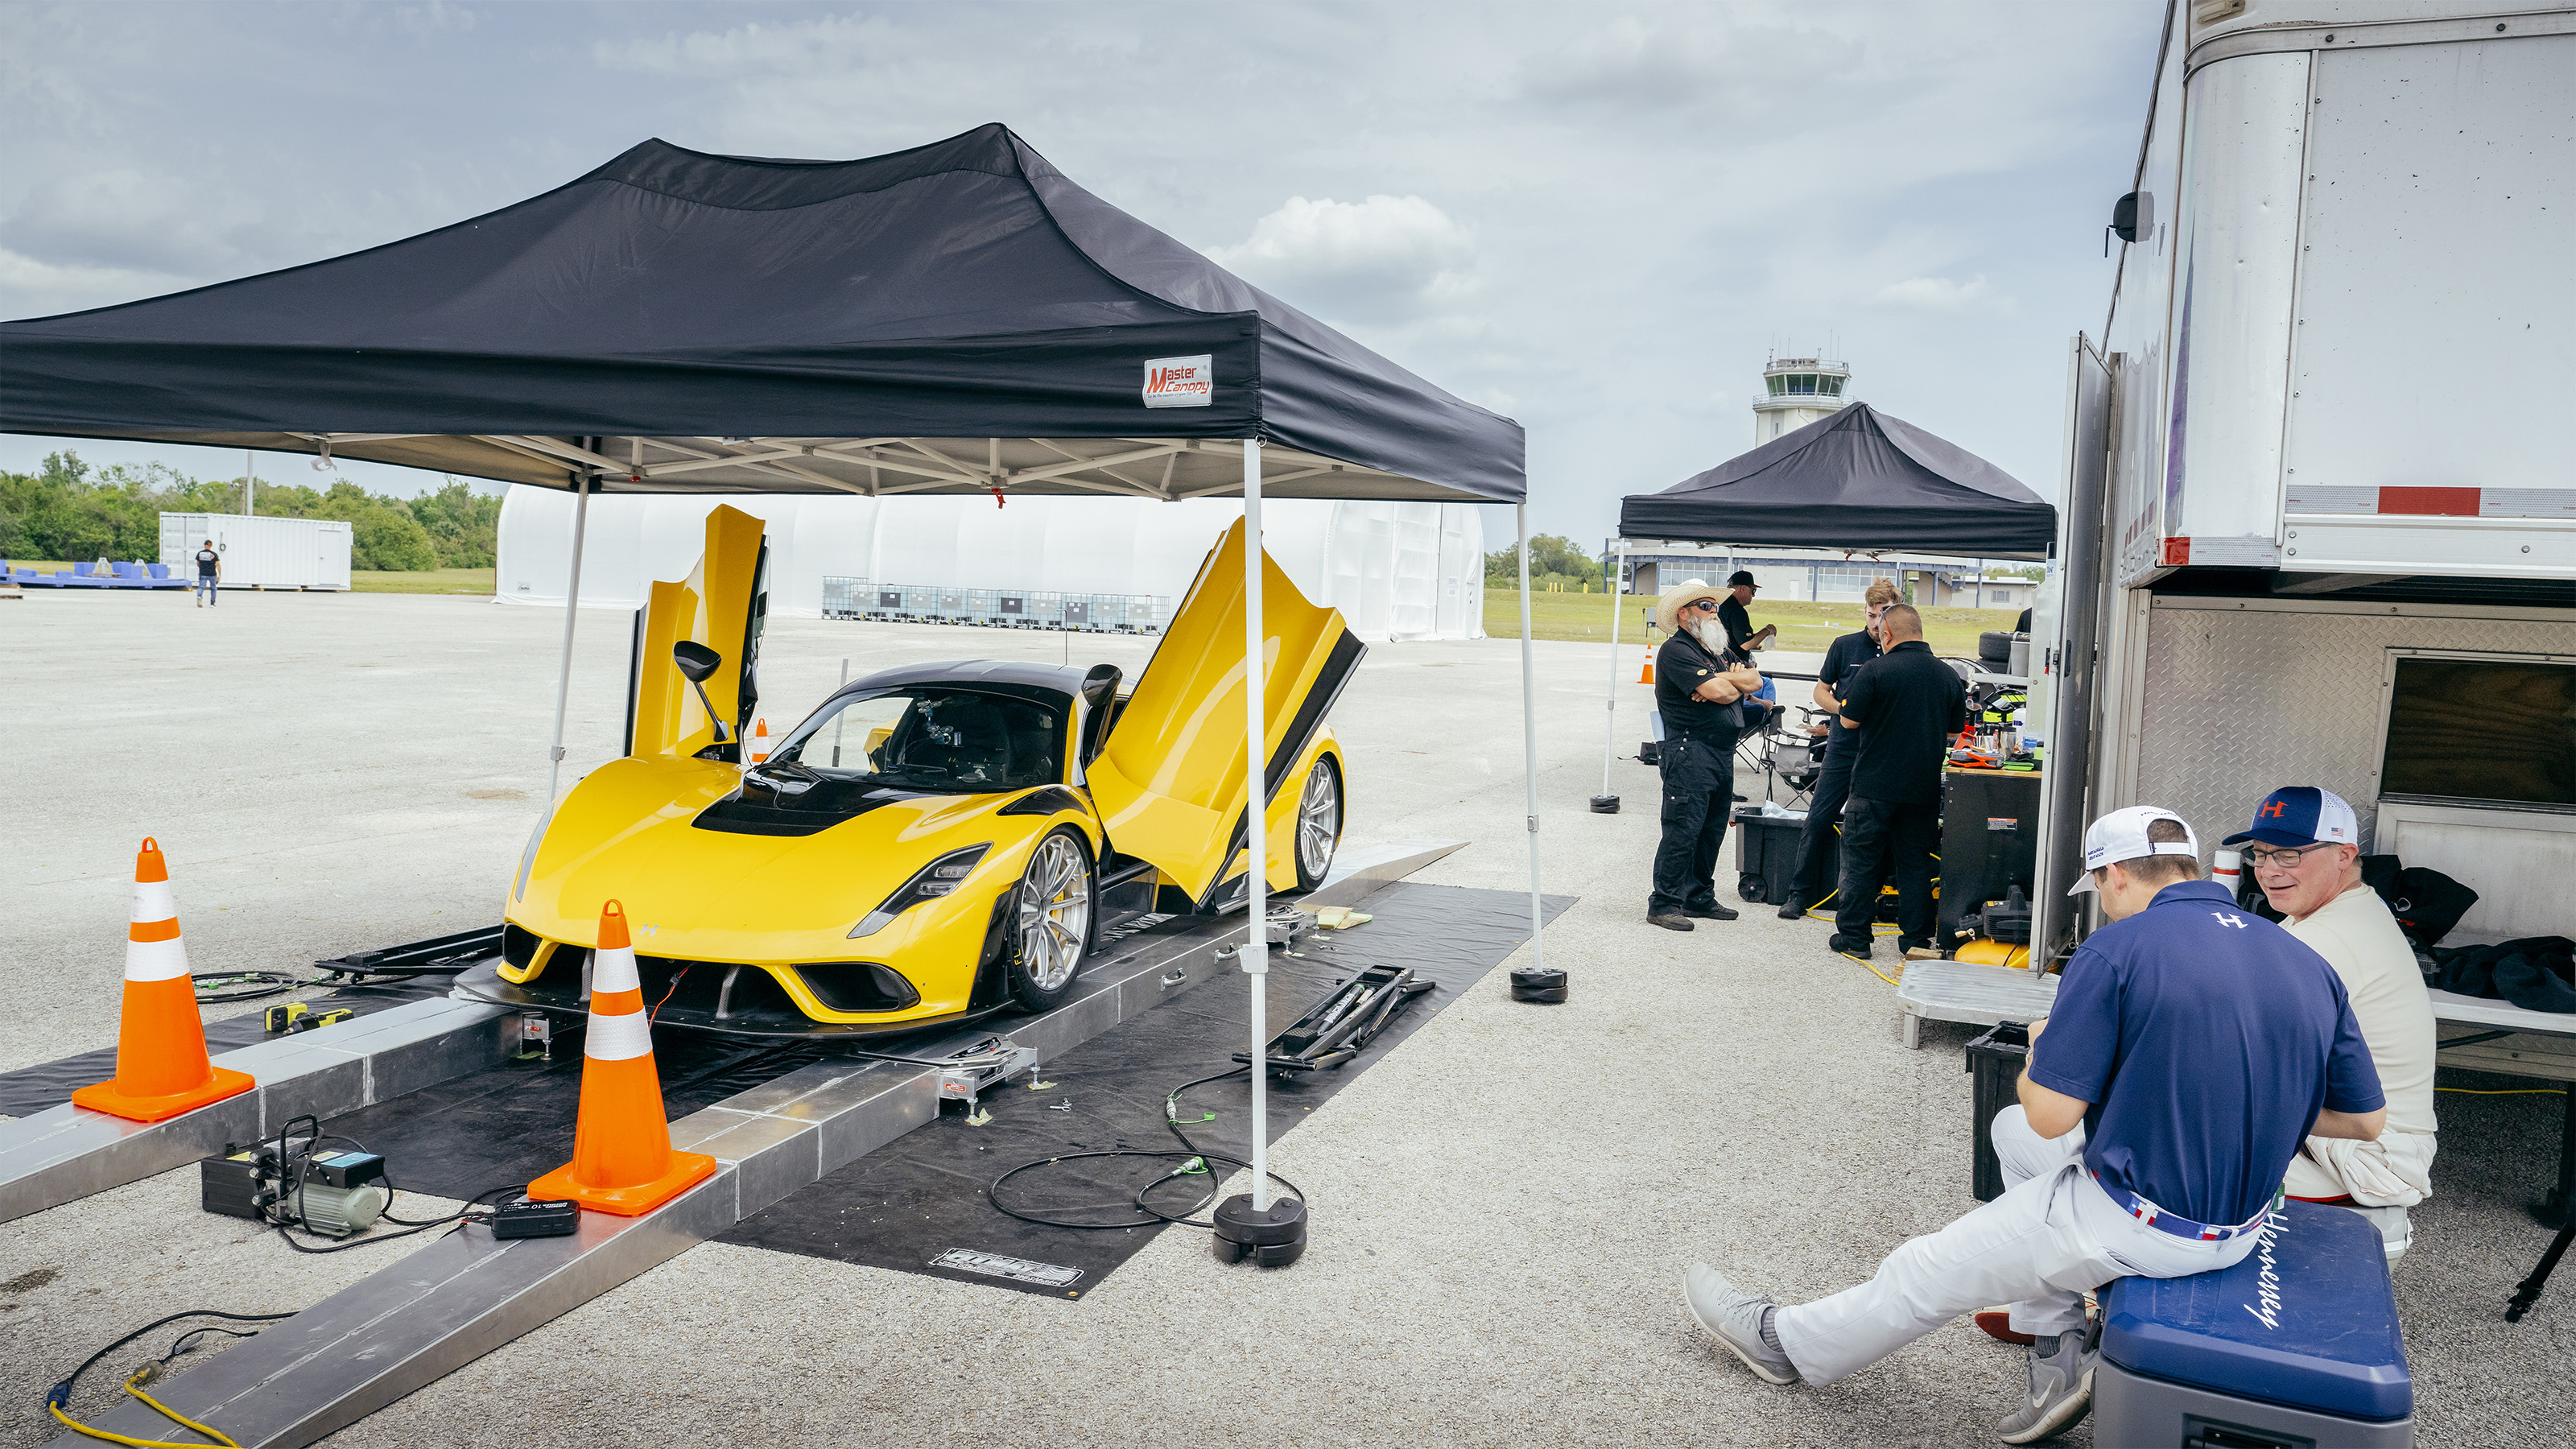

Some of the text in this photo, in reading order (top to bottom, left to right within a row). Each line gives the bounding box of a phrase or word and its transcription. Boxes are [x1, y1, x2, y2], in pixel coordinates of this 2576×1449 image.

[1146, 365, 1197, 393] Master
[1166, 381, 1210, 394] Canopy
[2259, 801, 2289, 818] H
[2211, 911, 2248, 929] H
[1013, 948, 1022, 966] FL
[2244, 1212, 2289, 1331] Hennessey
